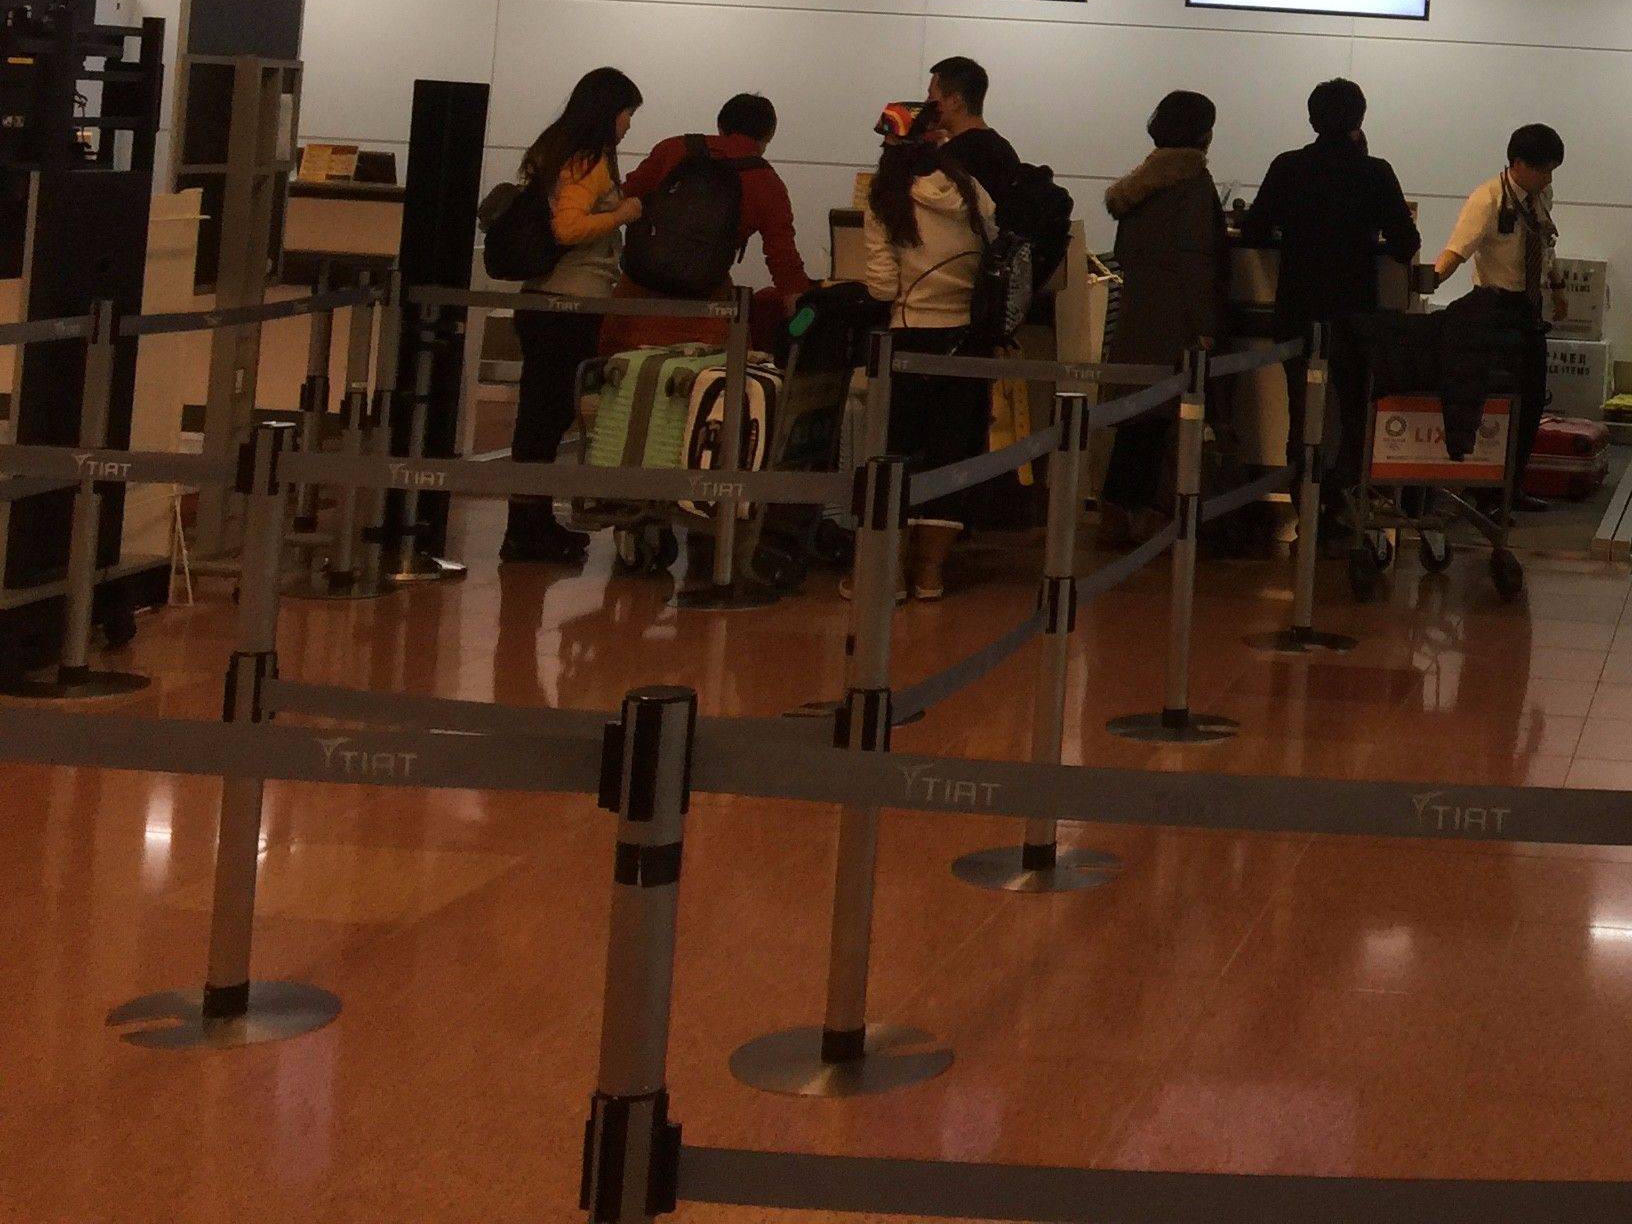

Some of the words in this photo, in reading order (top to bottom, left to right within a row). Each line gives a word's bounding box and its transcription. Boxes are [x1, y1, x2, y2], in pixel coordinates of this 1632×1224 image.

[1414, 426, 1446, 444] LIX
[88, 461, 132, 478] TIAT
[403, 471, 447, 487] TIAT
[703, 482, 745, 497] TIAT
[343, 751, 418, 777] TIAT
[921, 777, 1001, 806] TIAT
[1430, 805, 1512, 834] TIAT
